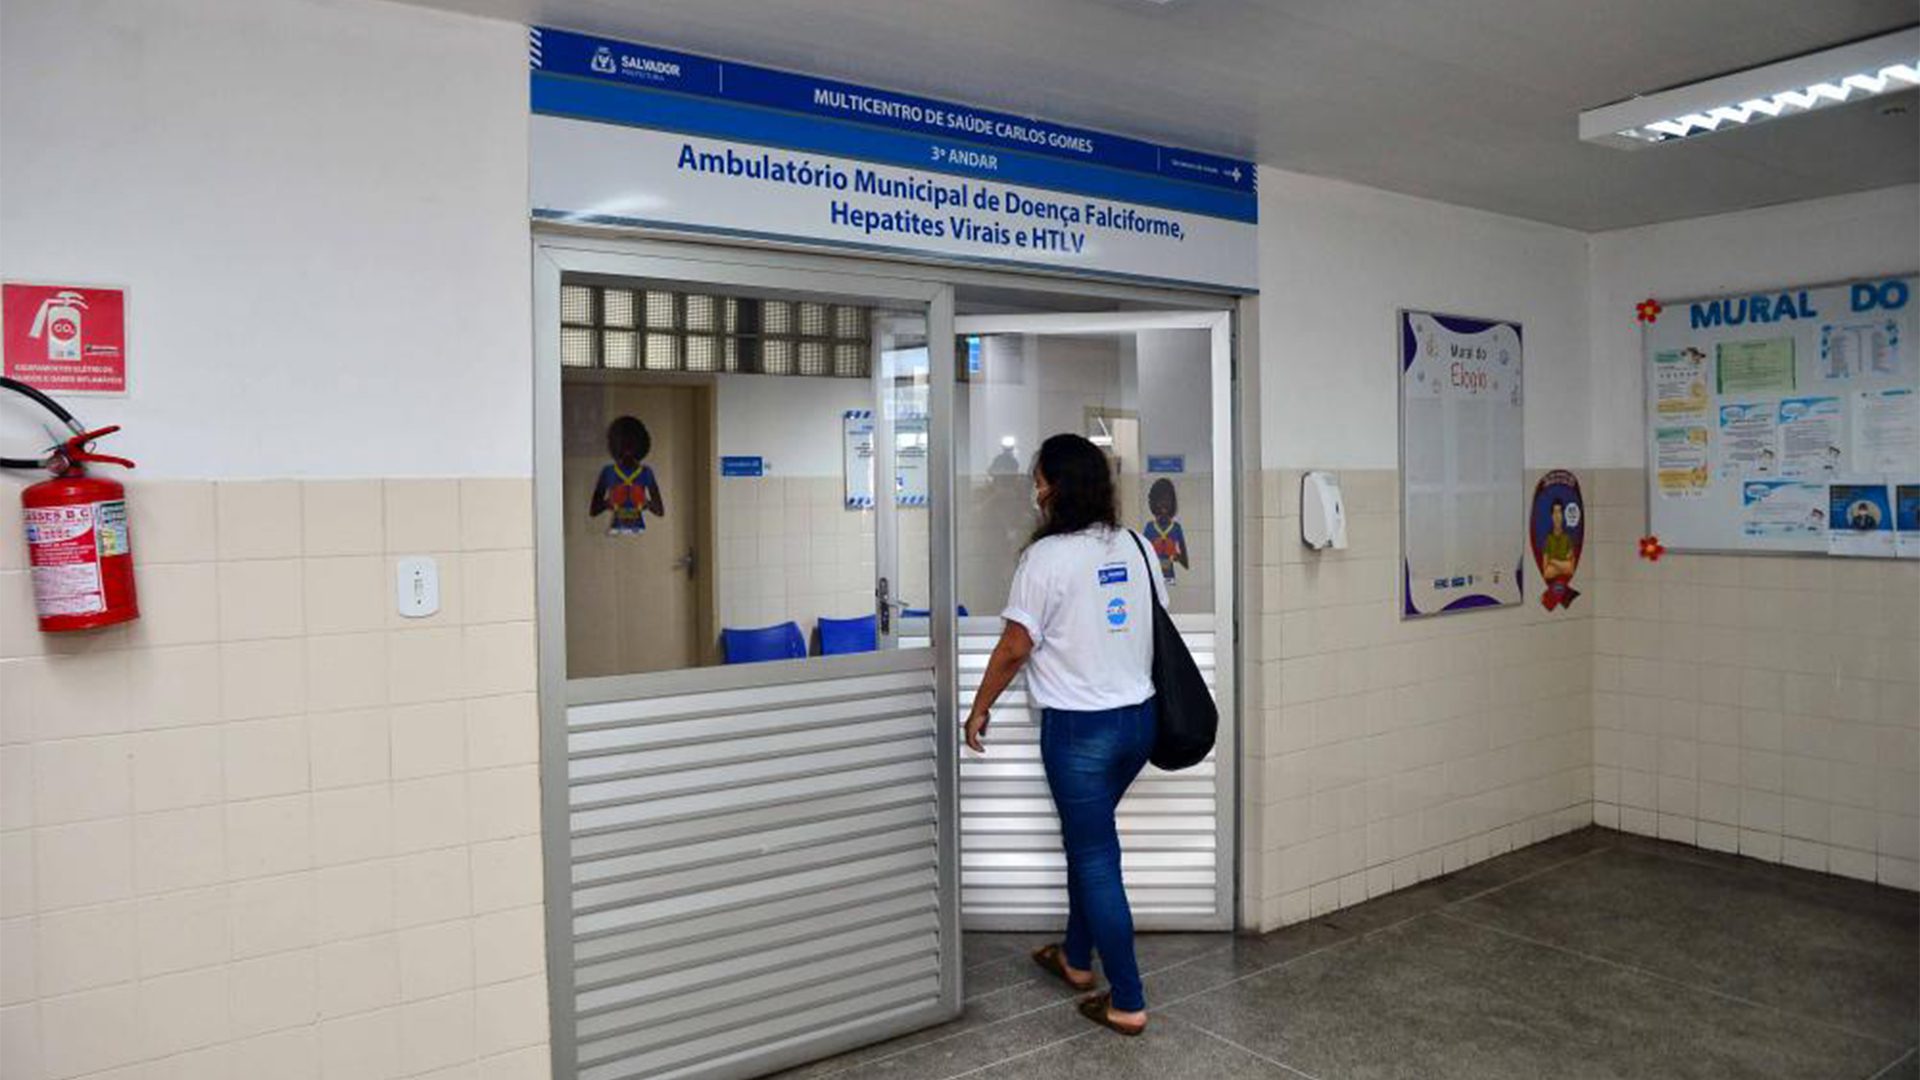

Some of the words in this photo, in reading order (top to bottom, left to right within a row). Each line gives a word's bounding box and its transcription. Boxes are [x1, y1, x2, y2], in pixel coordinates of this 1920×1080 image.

[621, 54, 681, 77] SALVADOR
[814, 88, 922, 122] MULTICENTRO
[924, 109, 945, 126] DE
[947, 113, 993, 135] SAÚDE
[995, 122, 1046, 145] CARLOS
[1048, 133, 1093, 153] GOMES
[948, 148, 998, 170] ANDAR
[678, 144, 848, 190] Ambulatório
[855, 169, 967, 209] Municipal
[973, 187, 1000, 212] de
[1005, 192, 1080, 227] Doença
[1085, 204, 1186, 241] Falciforme,
[831, 201, 945, 234] Hepatites
[950, 216, 1011, 246] Virais
[1015, 230, 1028, 247] e
[1032, 227, 1085, 253] HTLV
[1690, 291, 1818, 329] MURAL
[1851, 280, 1909, 312] DO
[1451, 362, 1488, 395] Elogio
